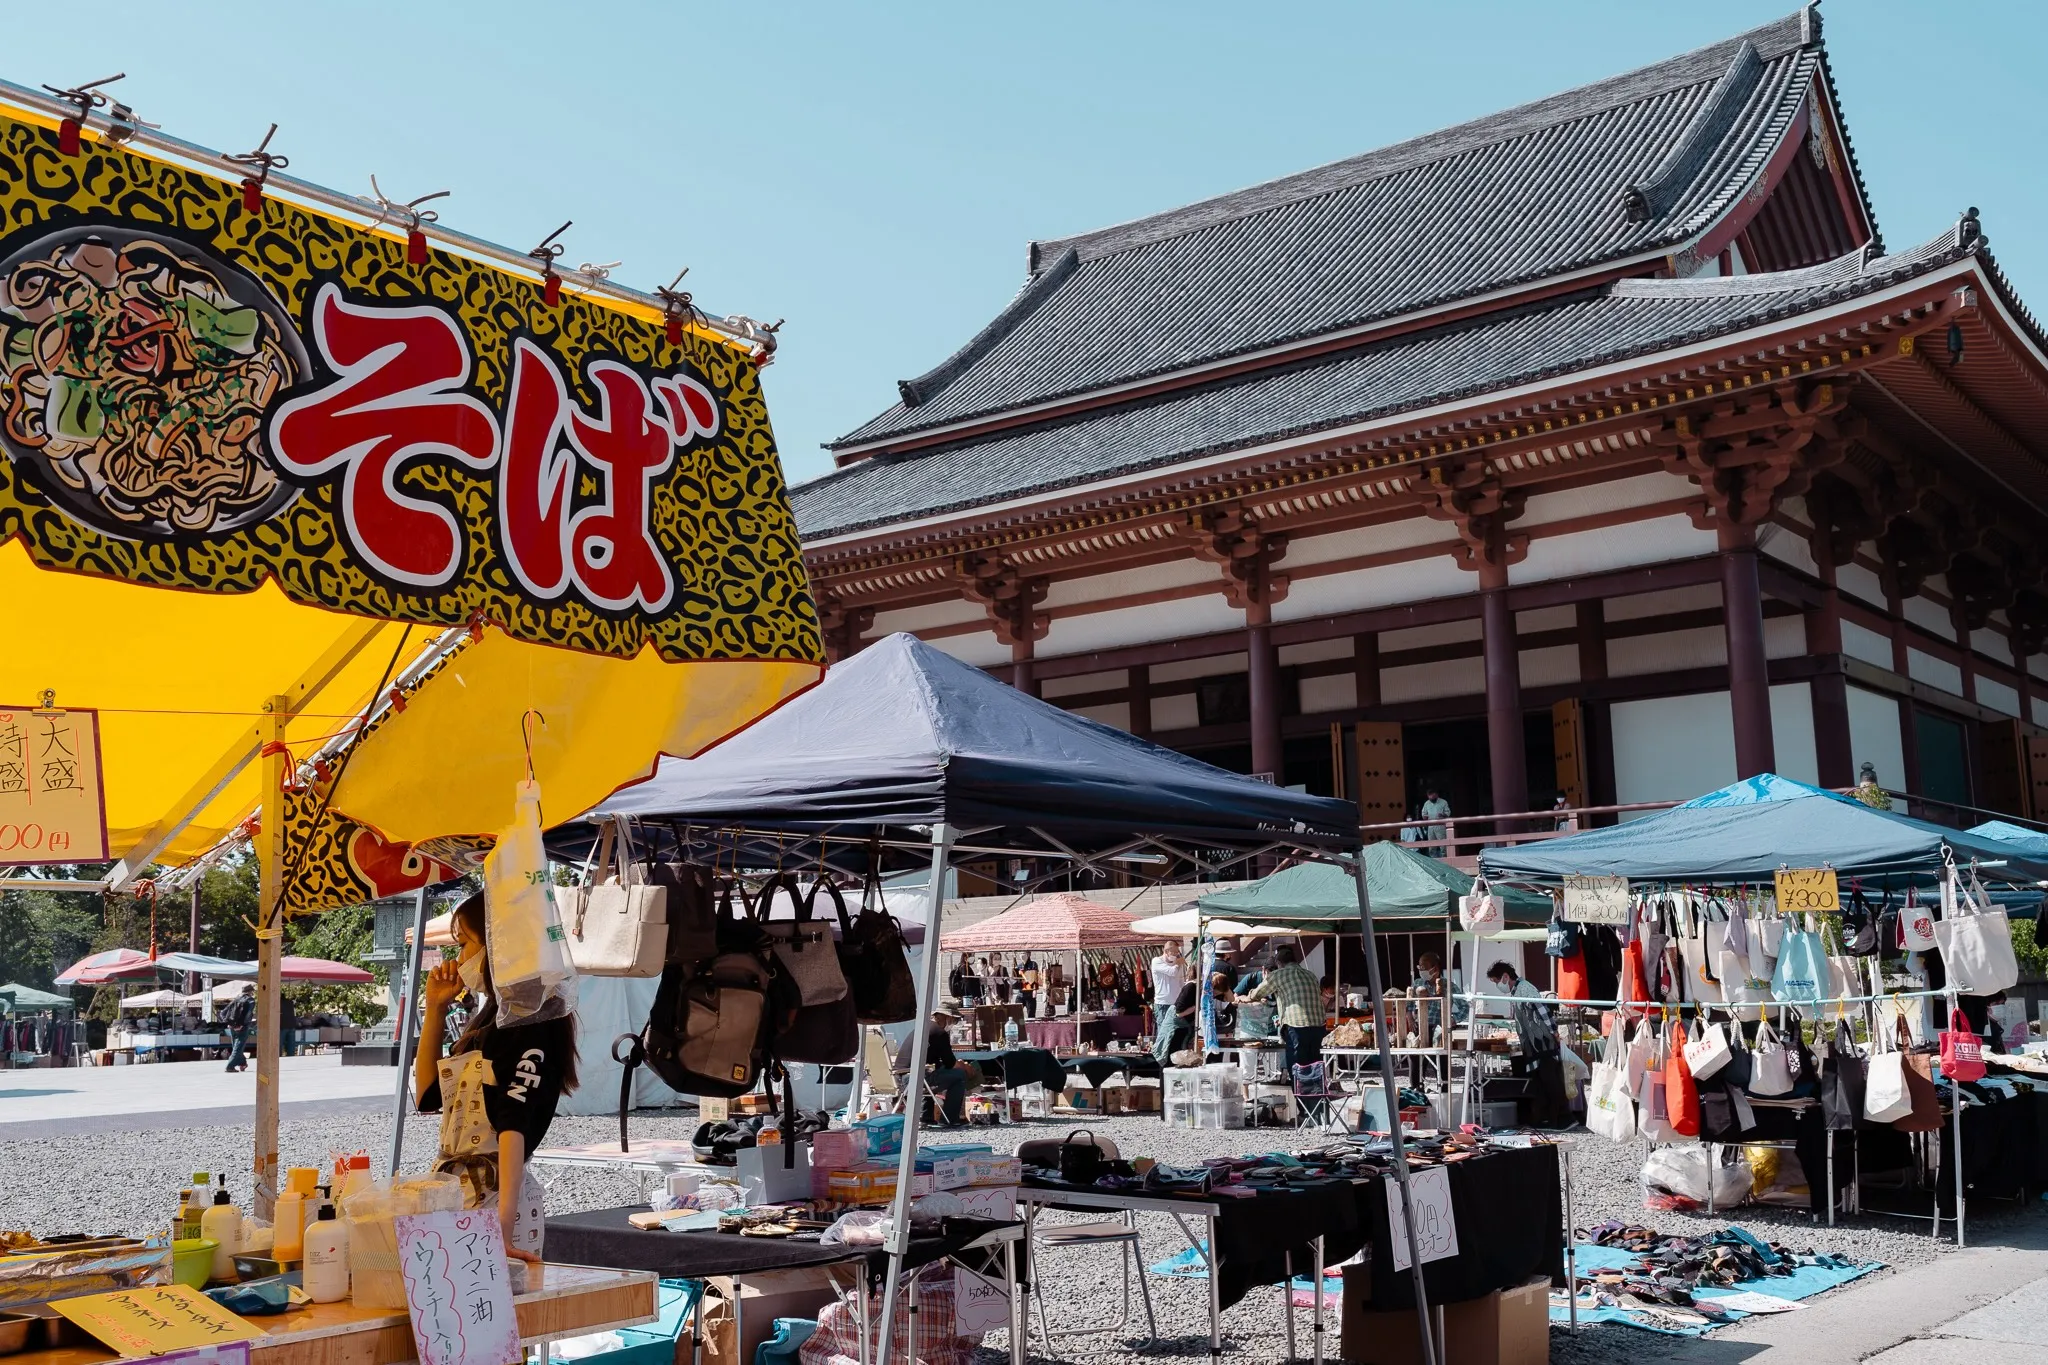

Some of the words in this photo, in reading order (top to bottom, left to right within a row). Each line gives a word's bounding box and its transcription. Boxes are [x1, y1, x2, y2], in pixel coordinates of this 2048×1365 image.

[271, 283, 719, 613] そば
[41, 722, 84, 793] 大盛
[1784, 888, 1834, 908] ¥300
[455, 1232, 493, 1325] アマニ油
